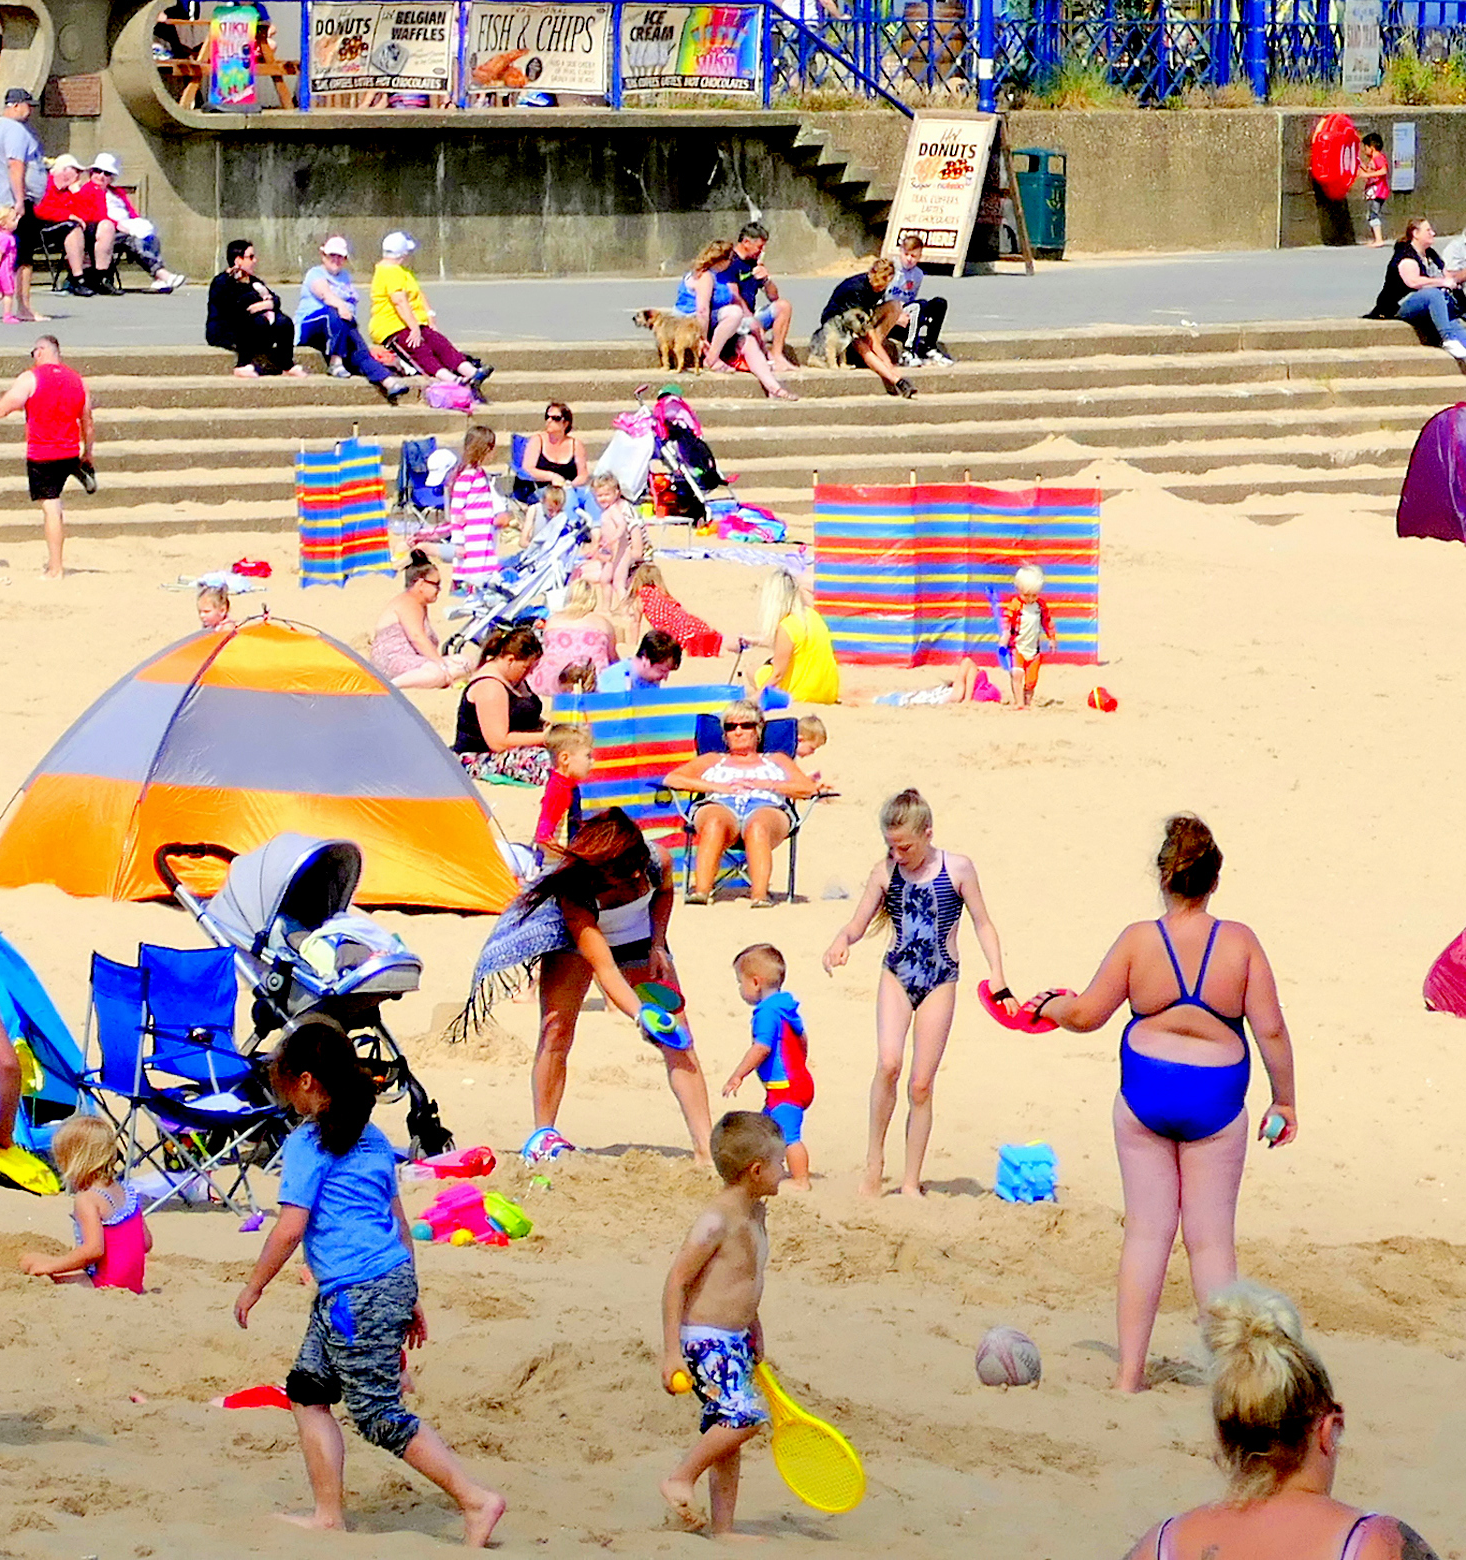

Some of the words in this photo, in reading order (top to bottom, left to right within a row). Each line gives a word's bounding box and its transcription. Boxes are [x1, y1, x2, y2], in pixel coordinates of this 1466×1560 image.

[395, 11, 446, 25] BELGIAN
[643, 10, 667, 25] ICE
[316, 18, 372, 35] DONUTS
[391, 27, 445, 41] WAFFLES
[477, 14, 515, 52] FISH
[517, 15, 530, 50] &
[536, 15, 595, 53] CHIPS
[630, 26, 674, 42] CREAM
[919, 143, 977, 159] DONUTS
[928, 230, 957, 246] HERE
